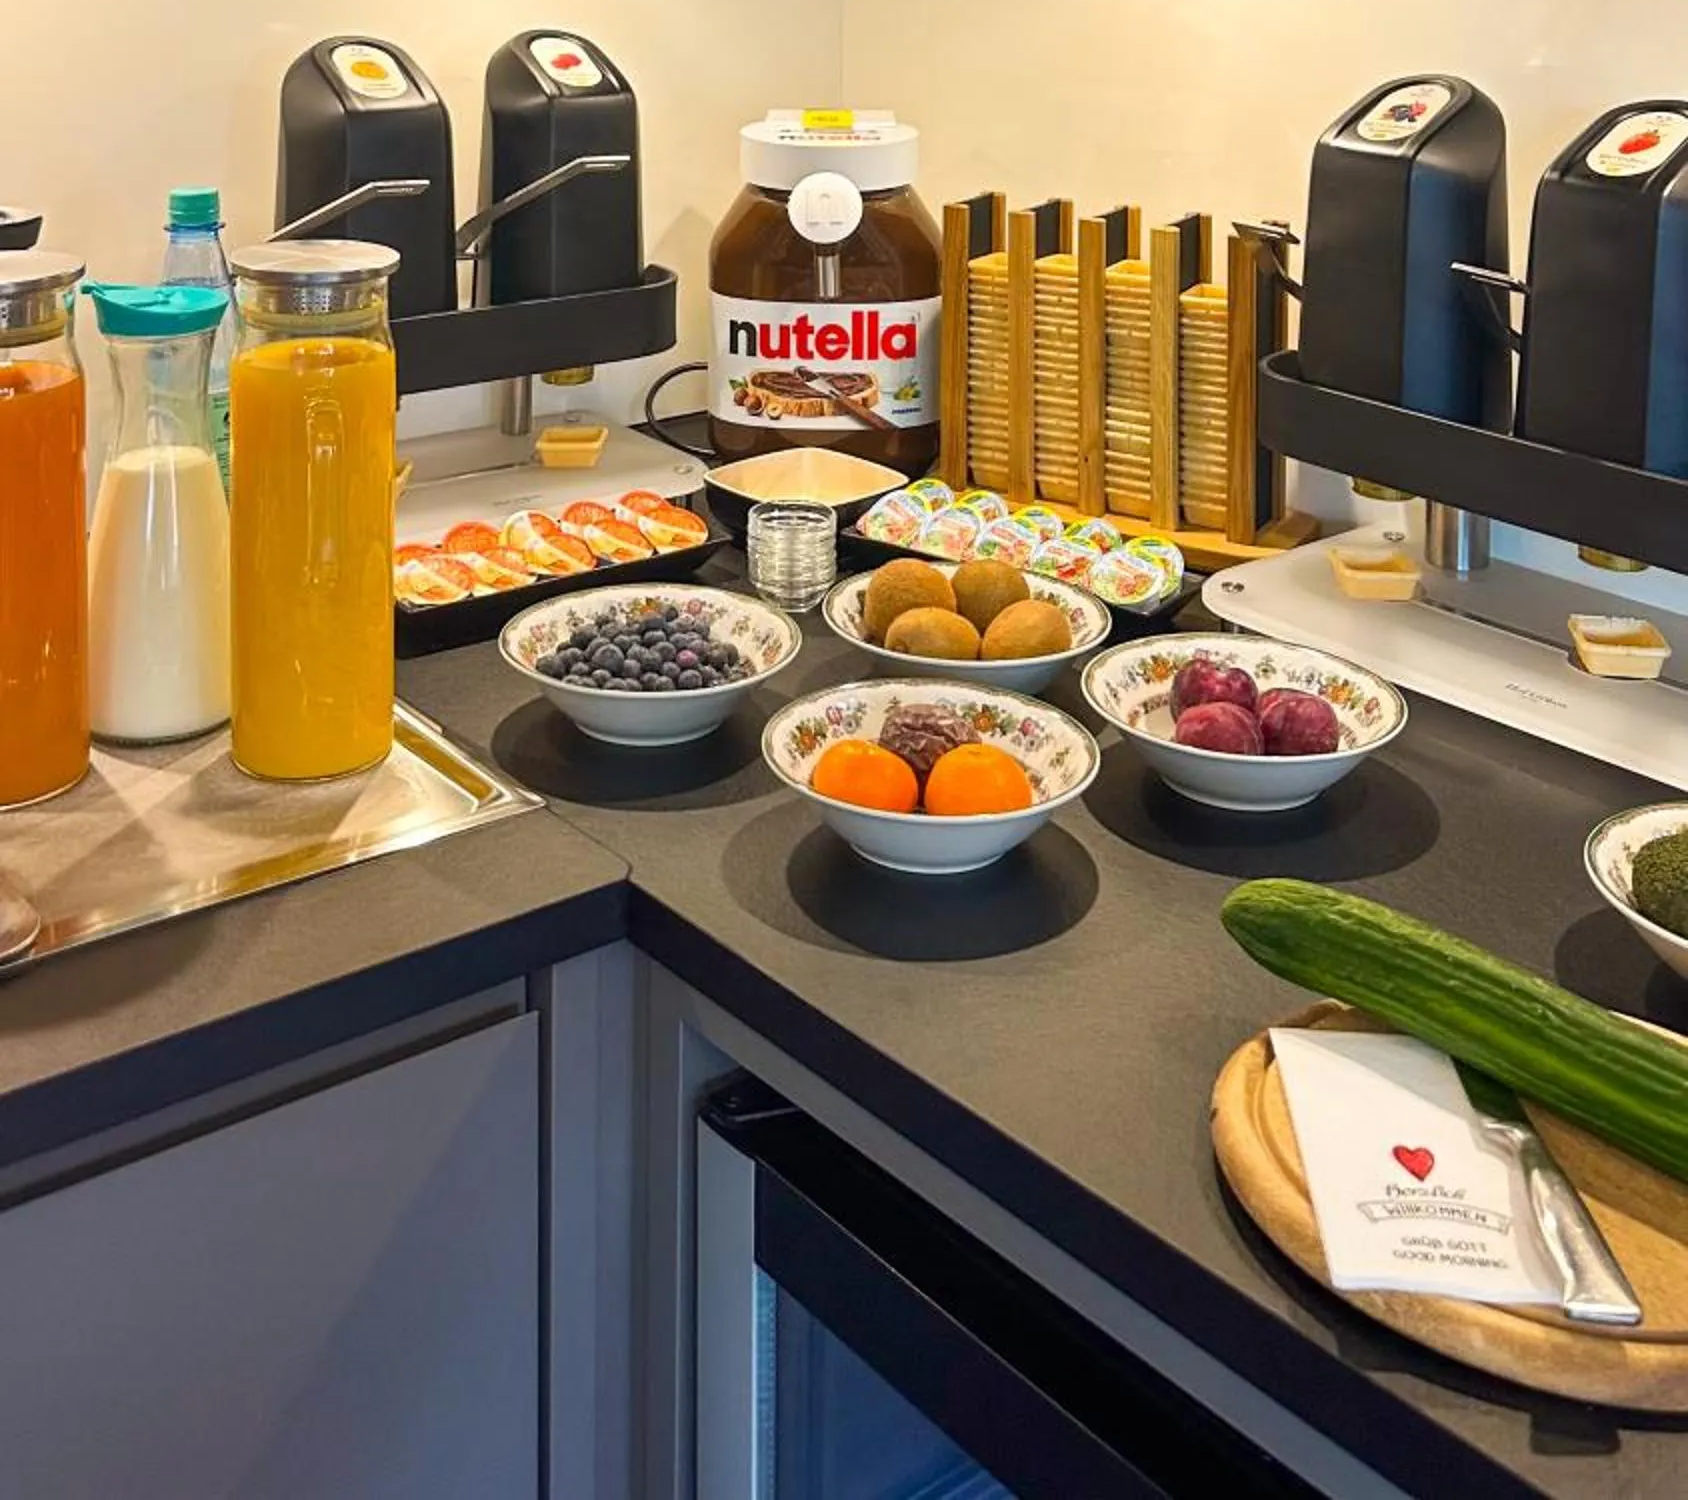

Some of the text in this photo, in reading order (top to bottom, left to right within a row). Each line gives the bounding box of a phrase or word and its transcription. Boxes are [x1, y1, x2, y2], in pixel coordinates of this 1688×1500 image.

[729, 310, 918, 361] nutella
[1447, 1238, 1487, 1253] GOTT
[1392, 1249, 1436, 1263] GOOD
